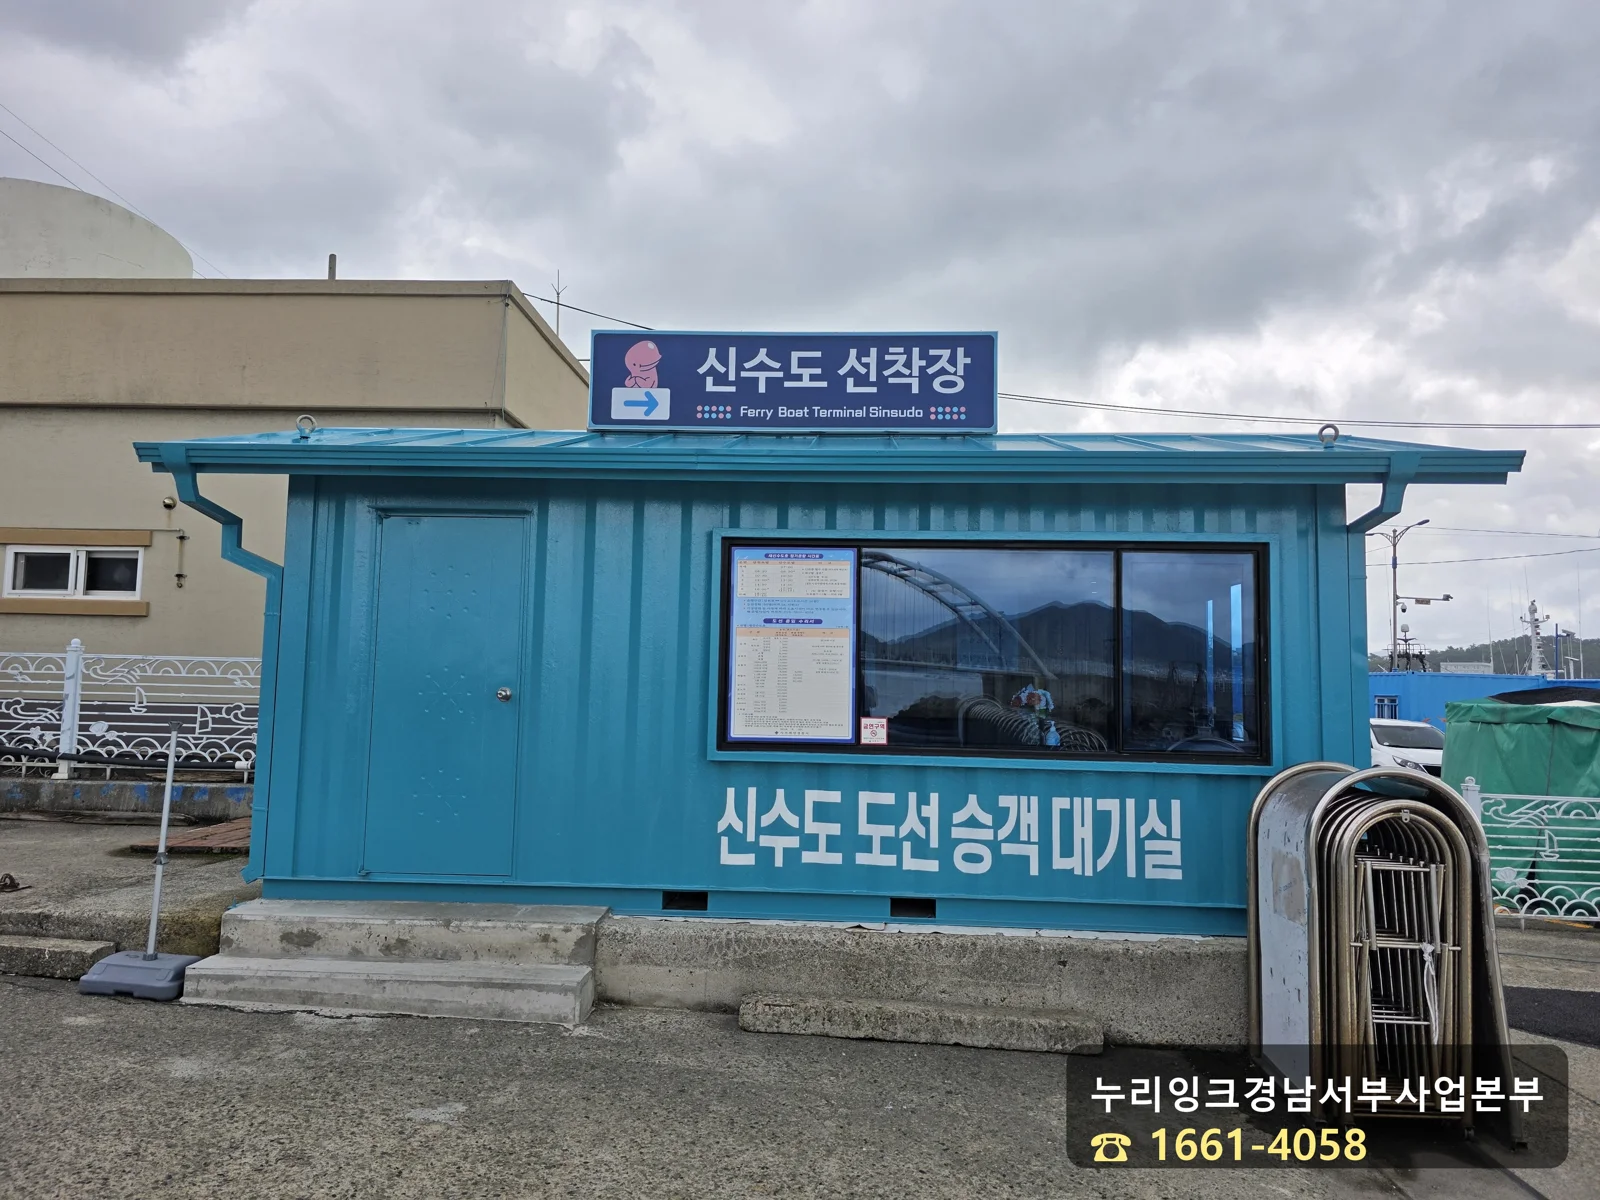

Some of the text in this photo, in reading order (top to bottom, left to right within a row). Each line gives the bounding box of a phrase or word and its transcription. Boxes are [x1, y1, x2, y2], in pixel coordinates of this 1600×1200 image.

[696, 346, 972, 394] 신수도 선착장
[740, 405, 924, 420] Ferry Boat Terminal Sinsudo
[717, 786, 1183, 880] 신수도 도선 승객 대기실
